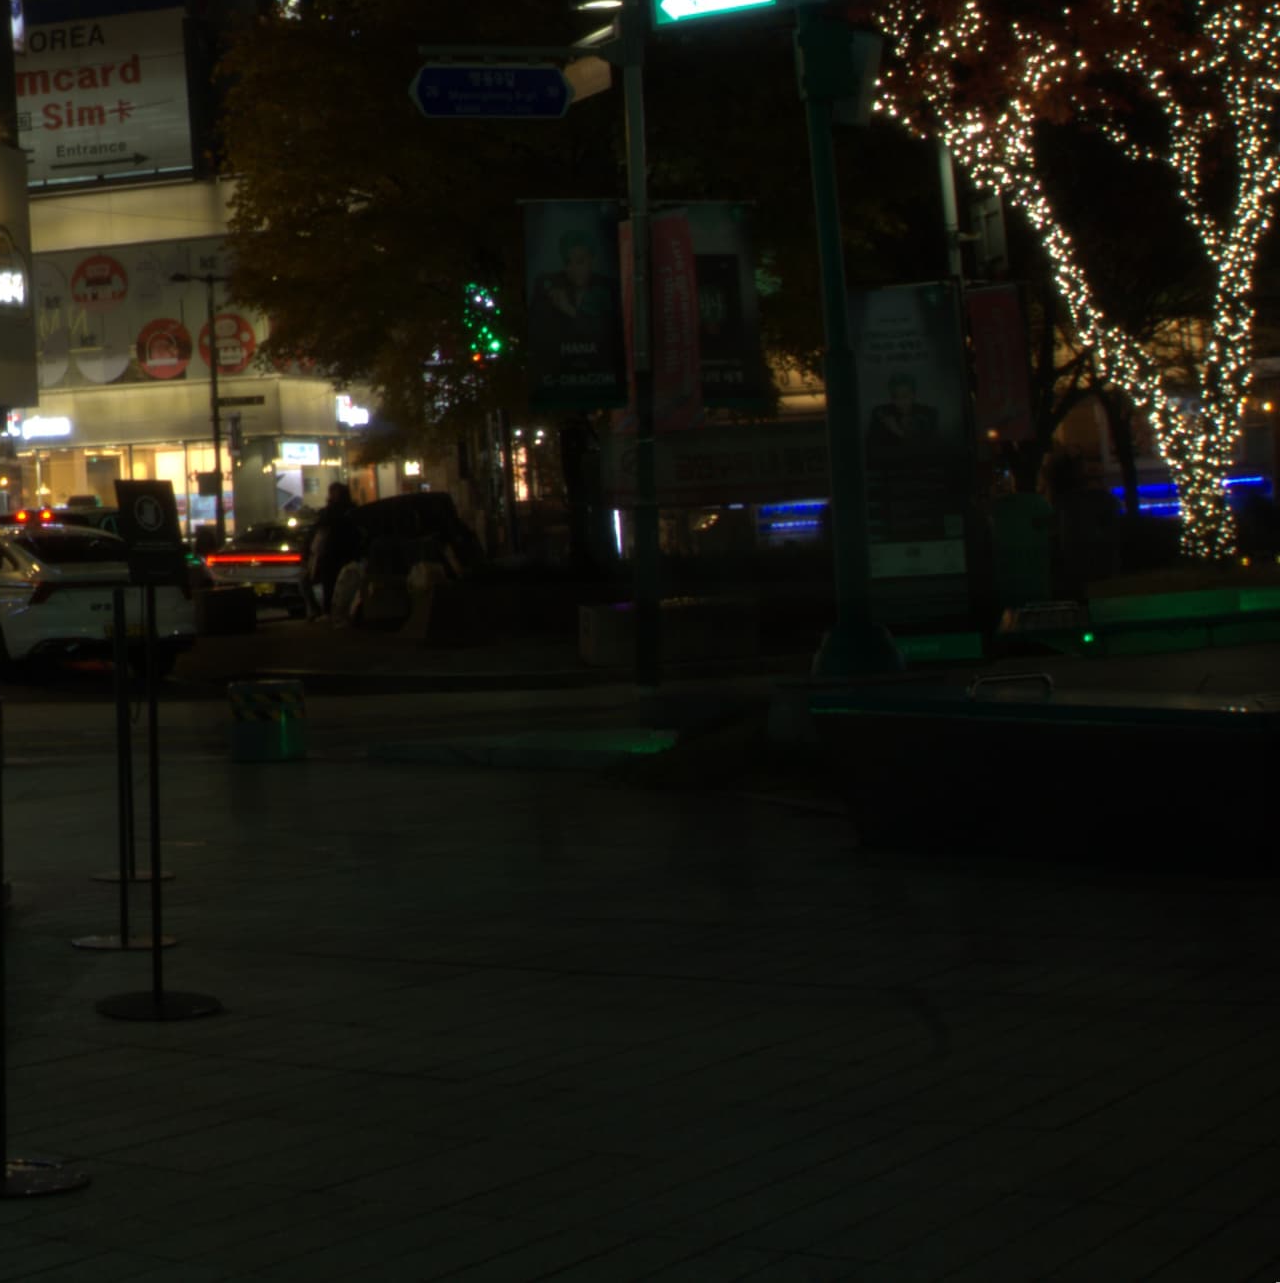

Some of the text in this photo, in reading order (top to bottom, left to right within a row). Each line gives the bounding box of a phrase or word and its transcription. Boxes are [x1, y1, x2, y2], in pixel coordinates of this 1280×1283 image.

[18, 22, 105, 56] OREA
[16, 54, 142, 97] mcard
[55, 140, 128, 159] Entrance
